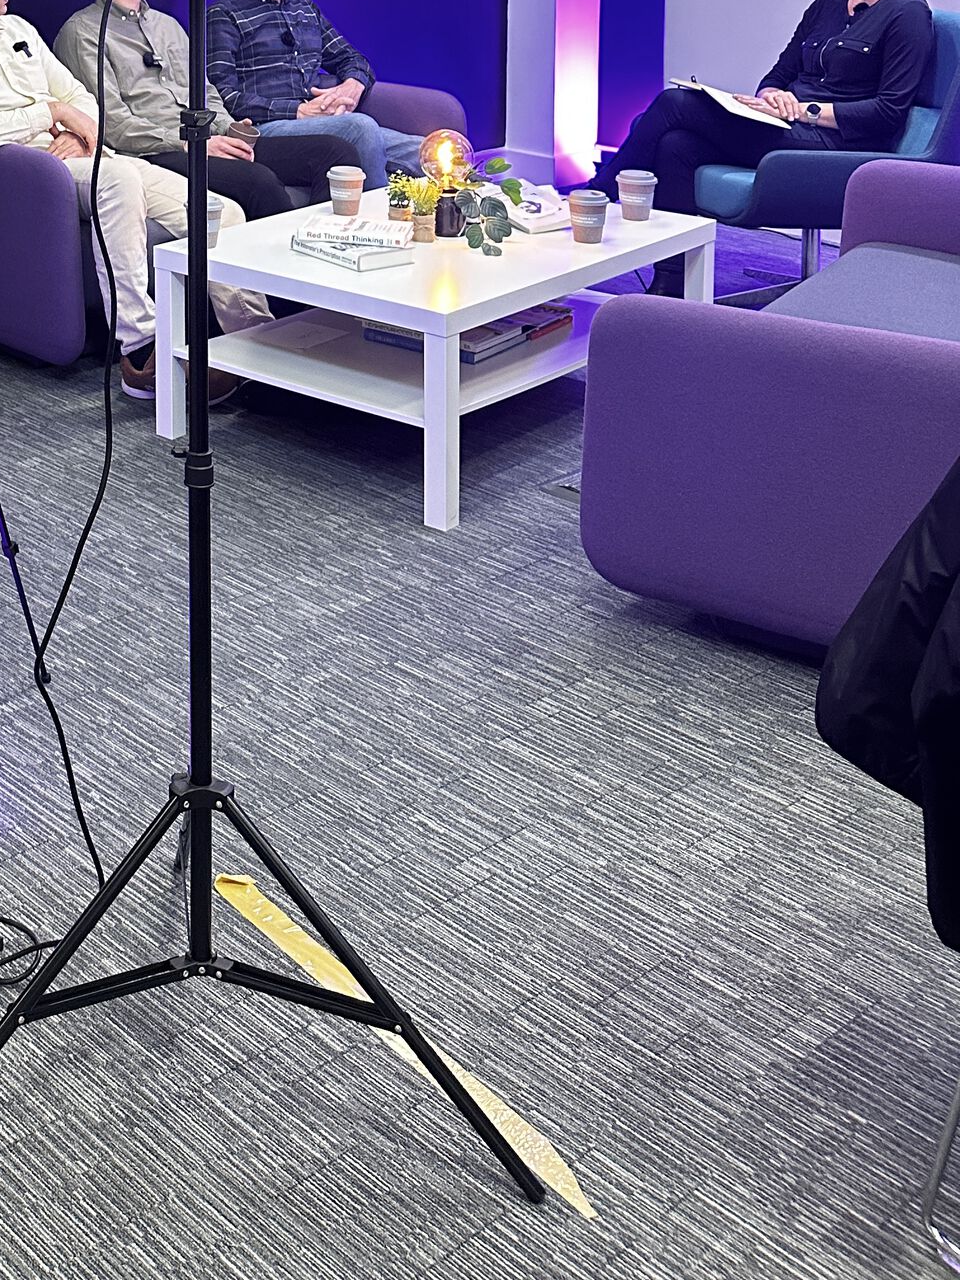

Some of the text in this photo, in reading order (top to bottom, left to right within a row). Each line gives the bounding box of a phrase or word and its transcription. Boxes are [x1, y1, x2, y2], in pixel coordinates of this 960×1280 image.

[306, 231, 384, 245] Red Thread Thinking
